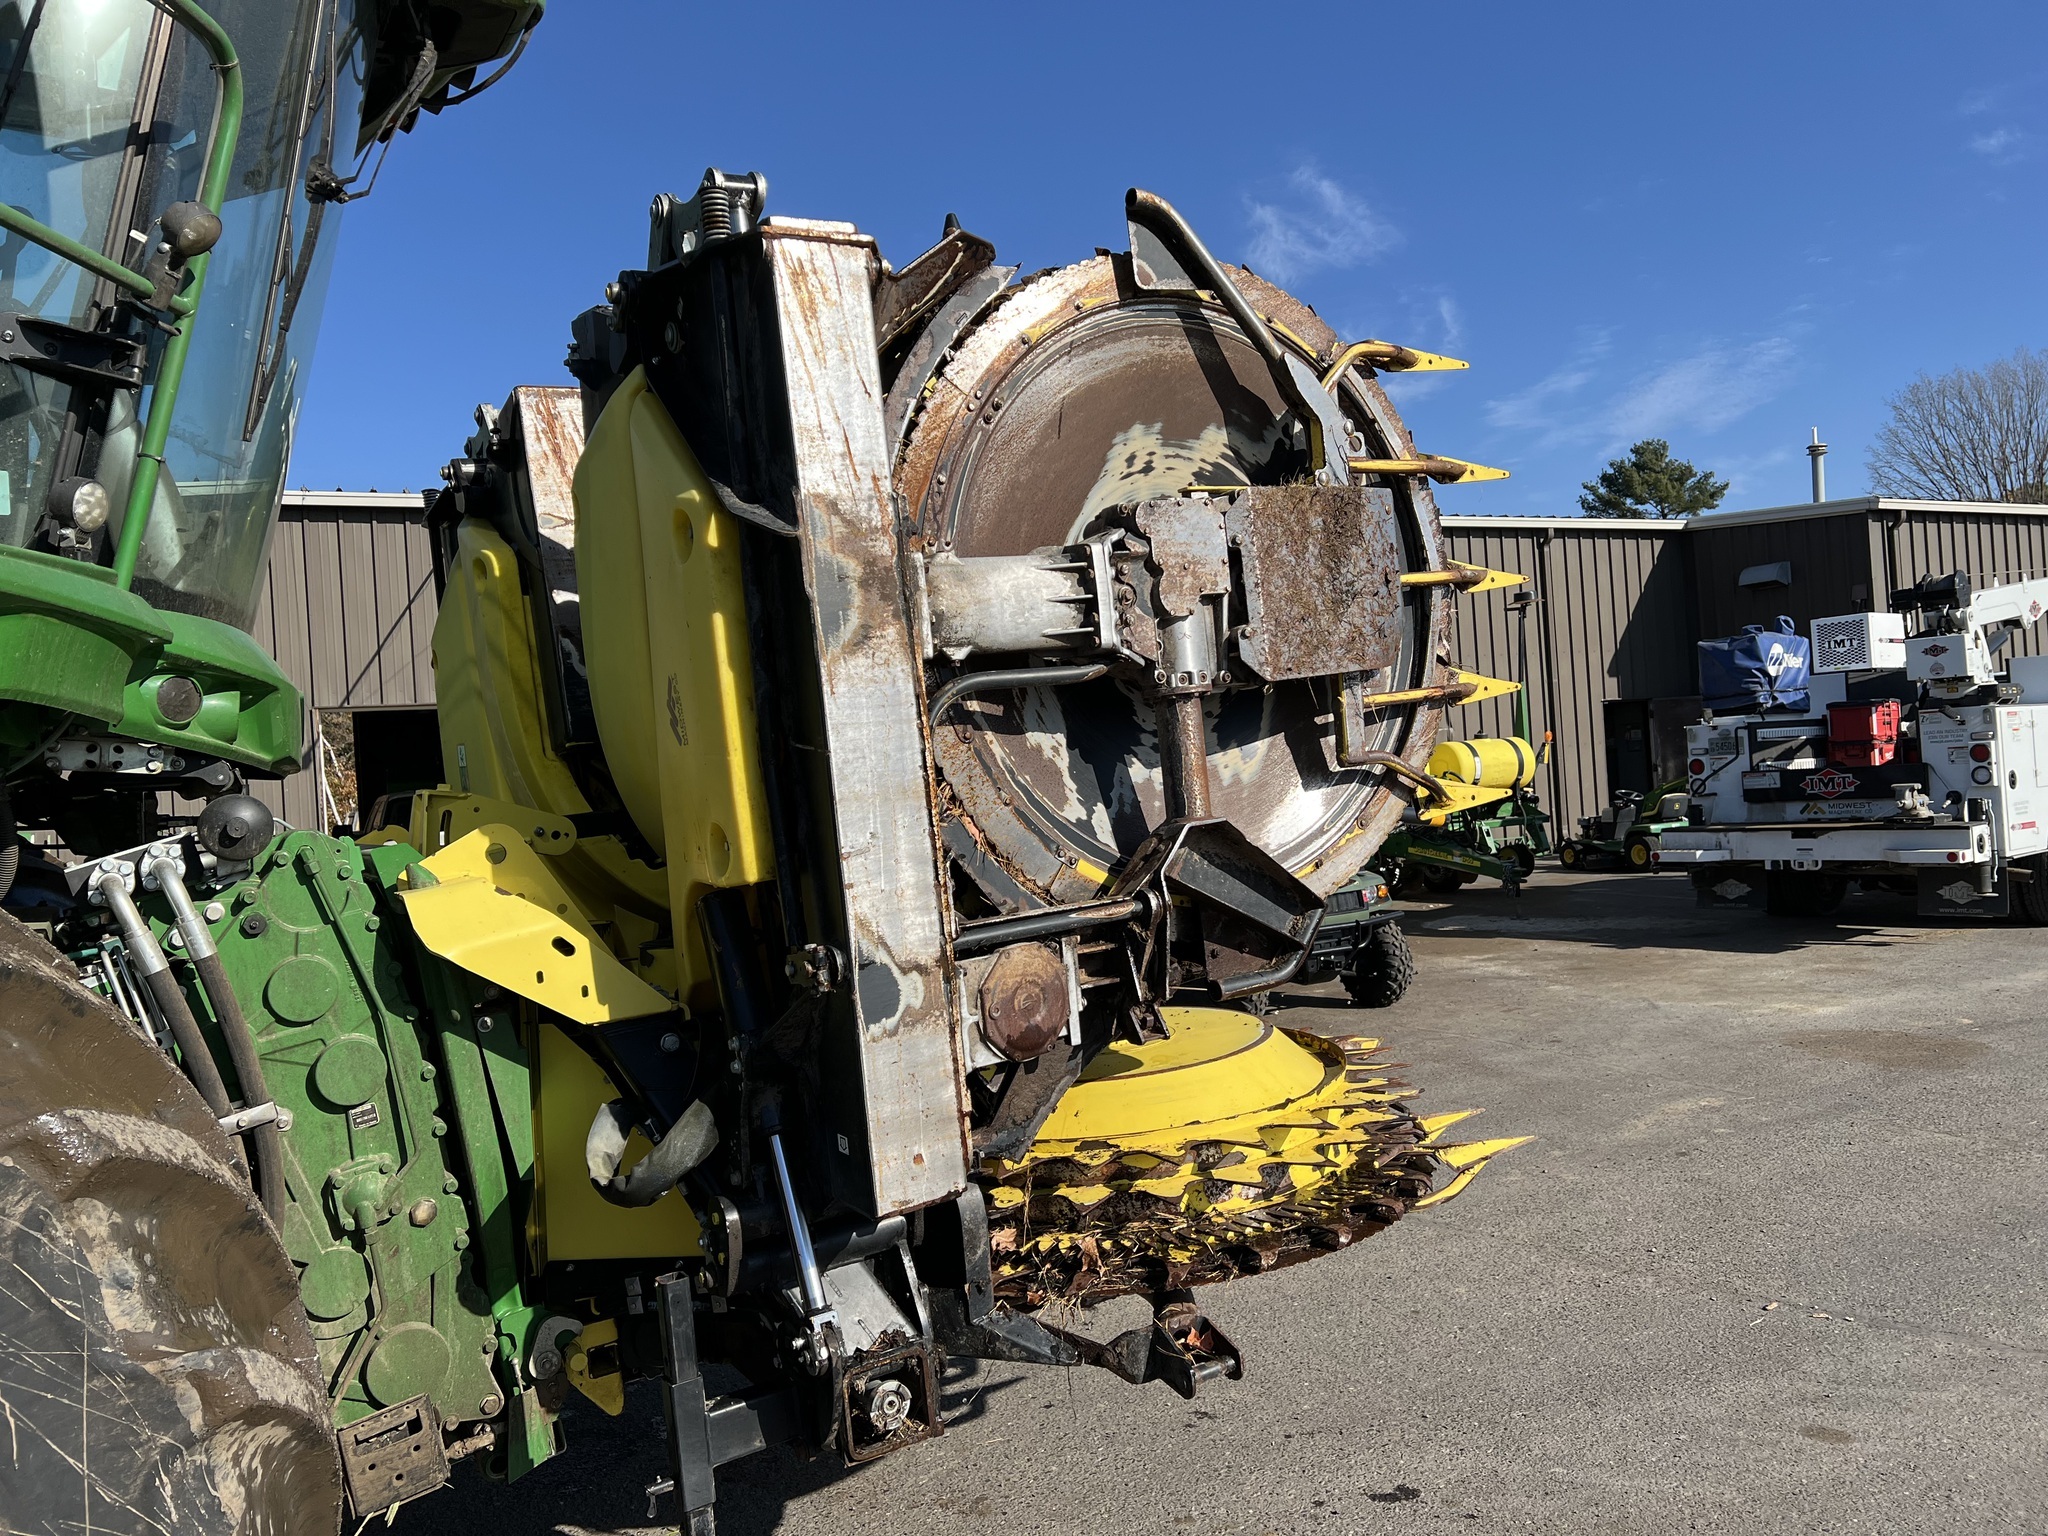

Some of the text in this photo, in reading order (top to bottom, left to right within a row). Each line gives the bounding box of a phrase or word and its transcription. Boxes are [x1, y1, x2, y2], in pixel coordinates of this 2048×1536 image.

[1825, 638, 1856, 650] IMT
[1806, 774, 1854, 793] IMT
[1827, 801, 1873, 810] MIDWEST
[1938, 906, 1984, 914] www.imt.com
